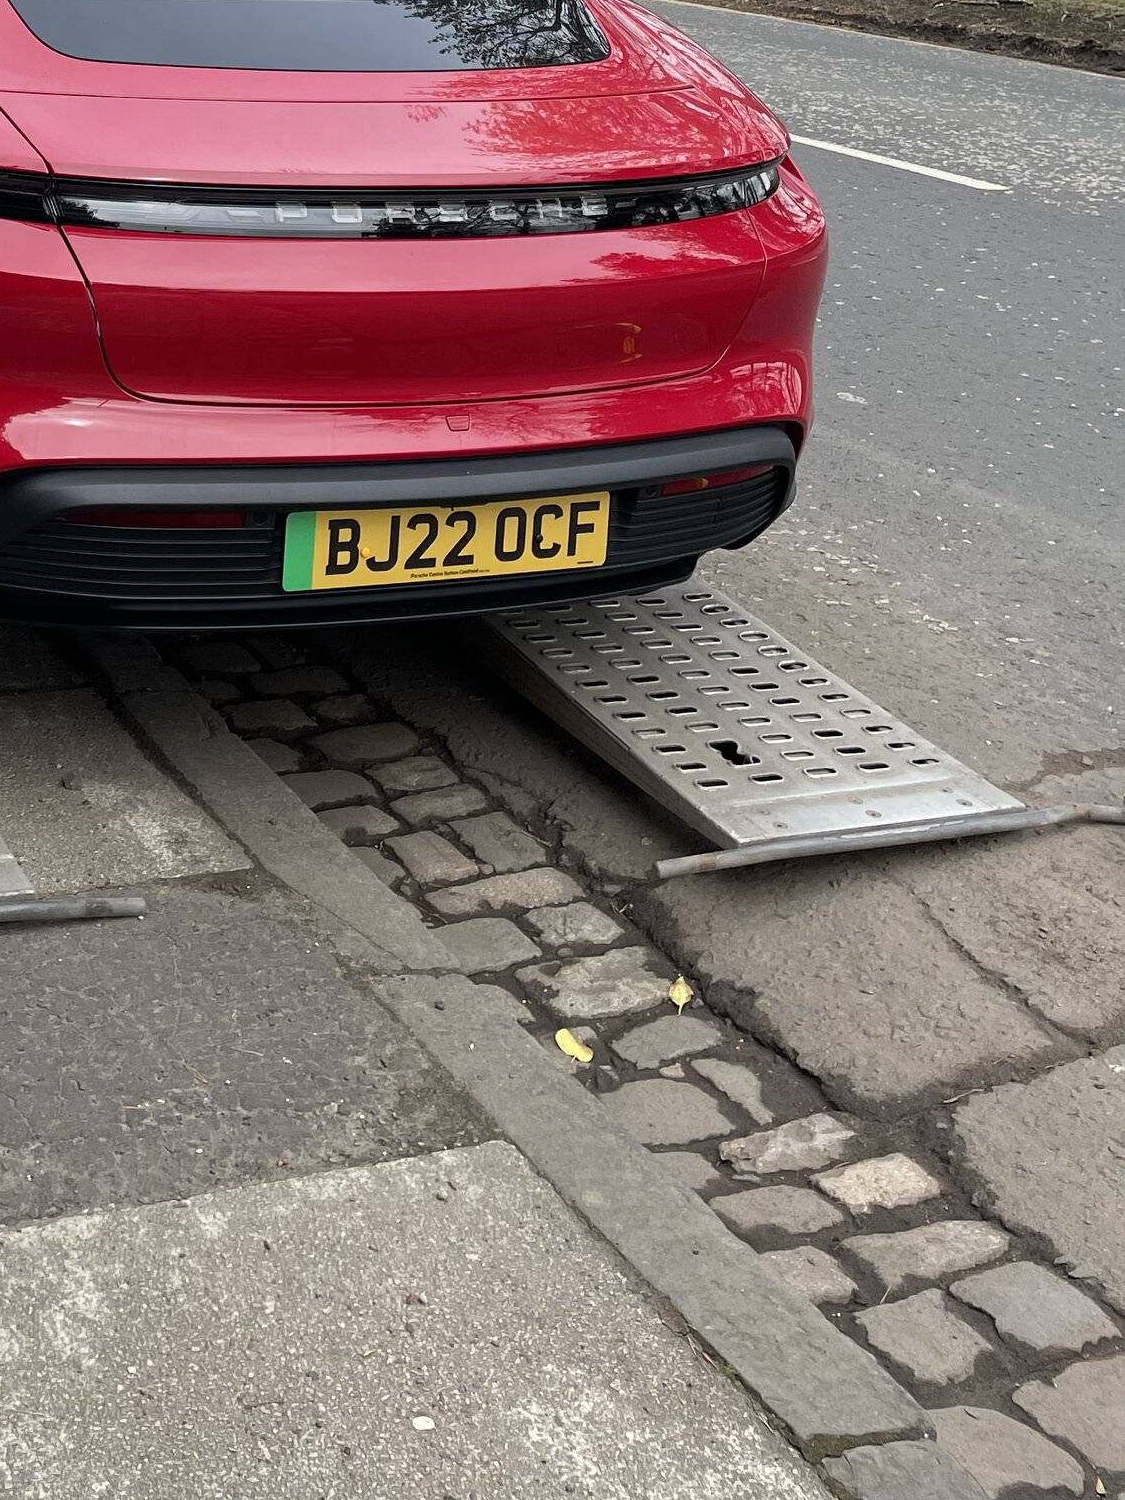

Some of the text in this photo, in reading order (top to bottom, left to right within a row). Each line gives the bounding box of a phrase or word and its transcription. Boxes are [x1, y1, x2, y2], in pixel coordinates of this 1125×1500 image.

[276, 196, 608, 224] PORSCHE
[325, 500, 601, 576] BJ22 OCF
